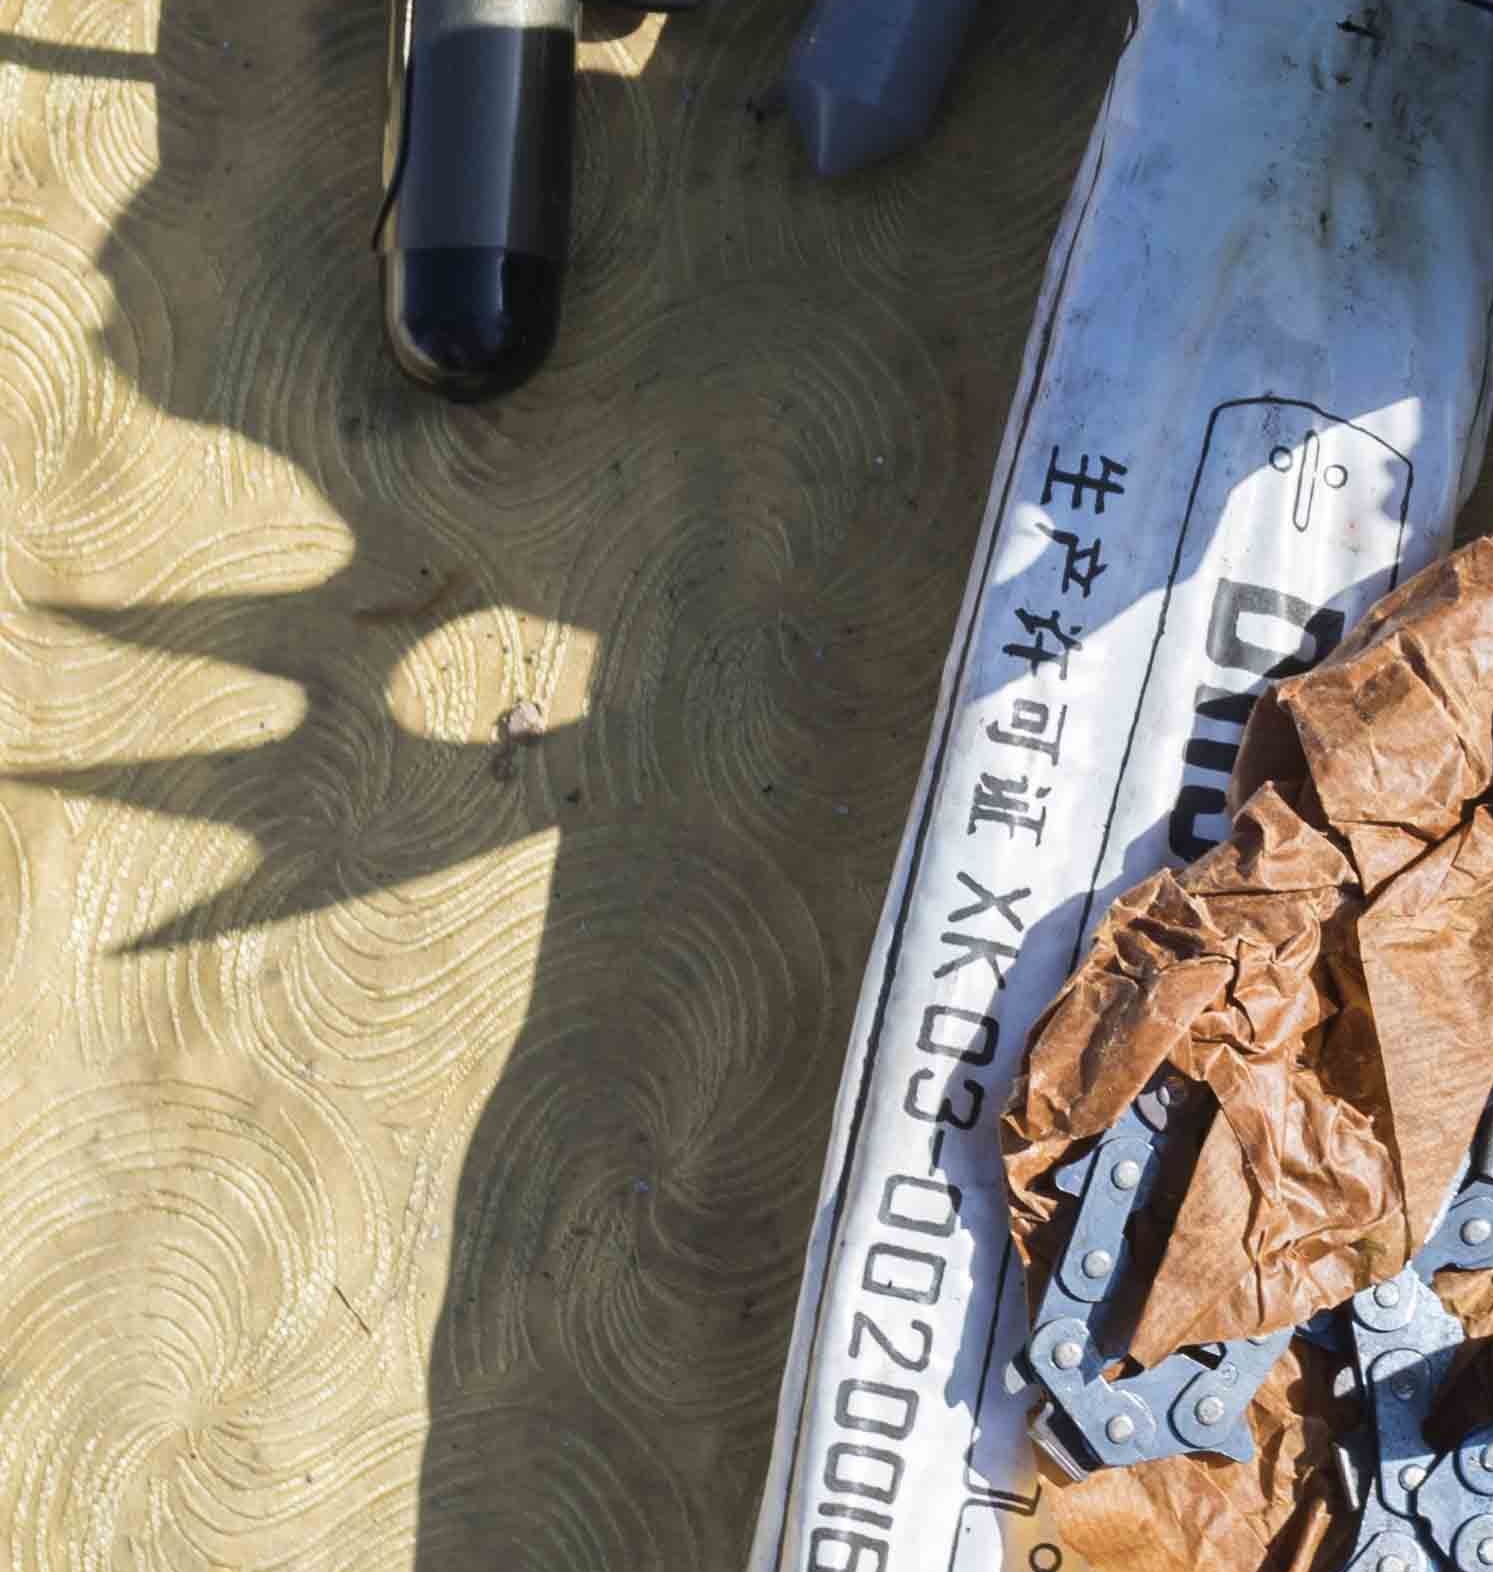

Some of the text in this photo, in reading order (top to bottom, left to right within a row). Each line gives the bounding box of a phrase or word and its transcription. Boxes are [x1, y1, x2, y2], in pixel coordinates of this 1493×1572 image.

[966, 444, 1129, 848] 生产许可证
